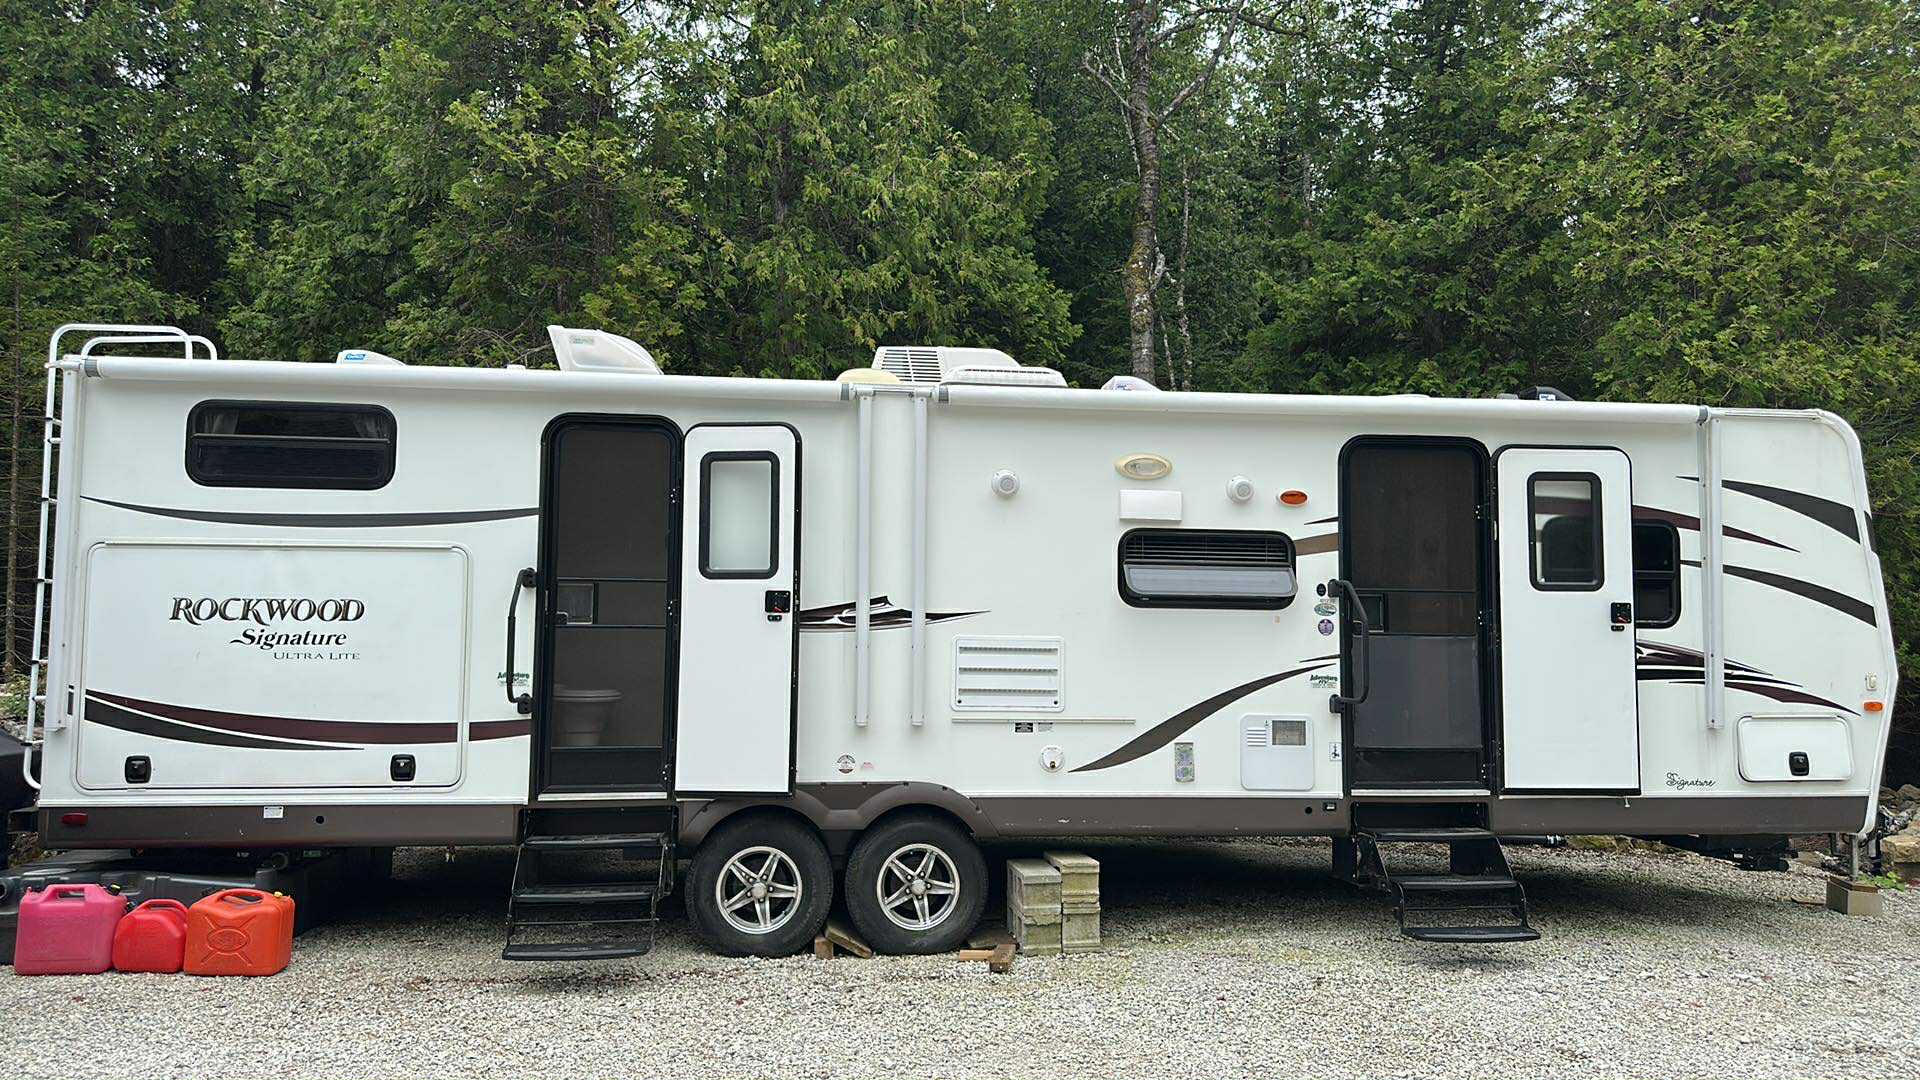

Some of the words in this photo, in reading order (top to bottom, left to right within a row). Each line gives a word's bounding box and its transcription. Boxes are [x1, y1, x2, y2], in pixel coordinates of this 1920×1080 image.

[169, 597, 365, 626] ROCKWOOD
[230, 628, 347, 650] Signature
[273, 652, 324, 660] ULTRA
[330, 652, 361, 660] LITE
[1666, 772, 1716, 790] Signature
